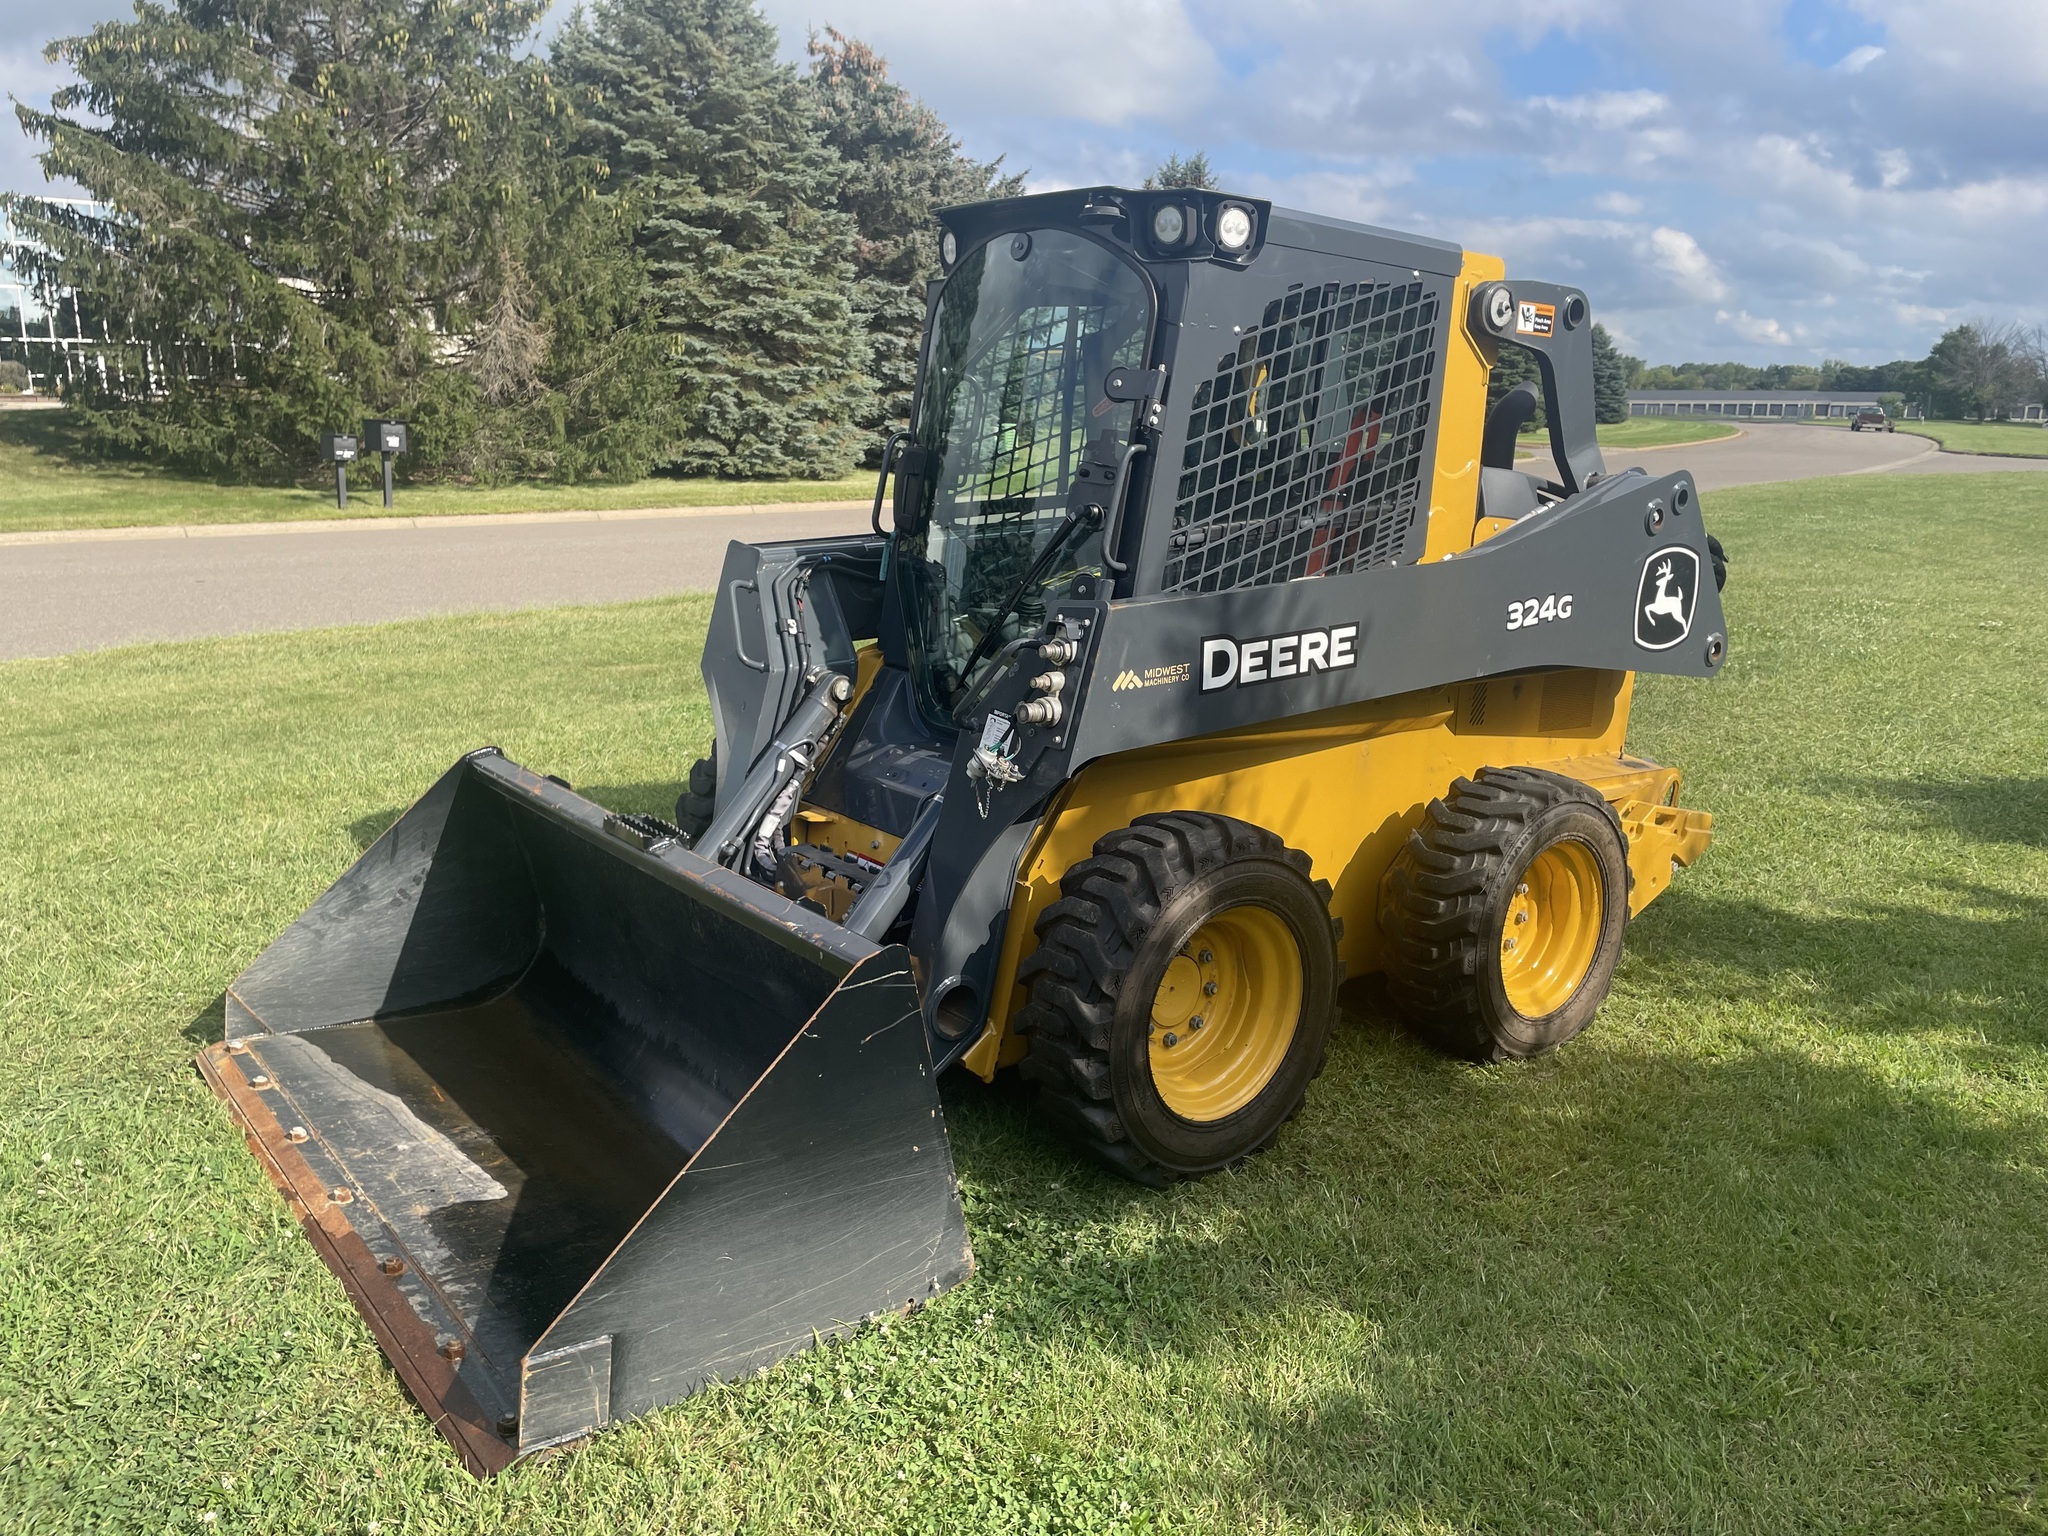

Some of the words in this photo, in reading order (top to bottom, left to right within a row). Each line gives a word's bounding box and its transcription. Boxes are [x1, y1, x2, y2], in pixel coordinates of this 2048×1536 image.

[1506, 594, 1573, 631] 324G
[1144, 663, 1190, 679] MIDWEST
[1202, 625, 1357, 691] DEERE
[1144, 675, 1180, 687] MACHINERY
[1181, 673, 1190, 682] CO
